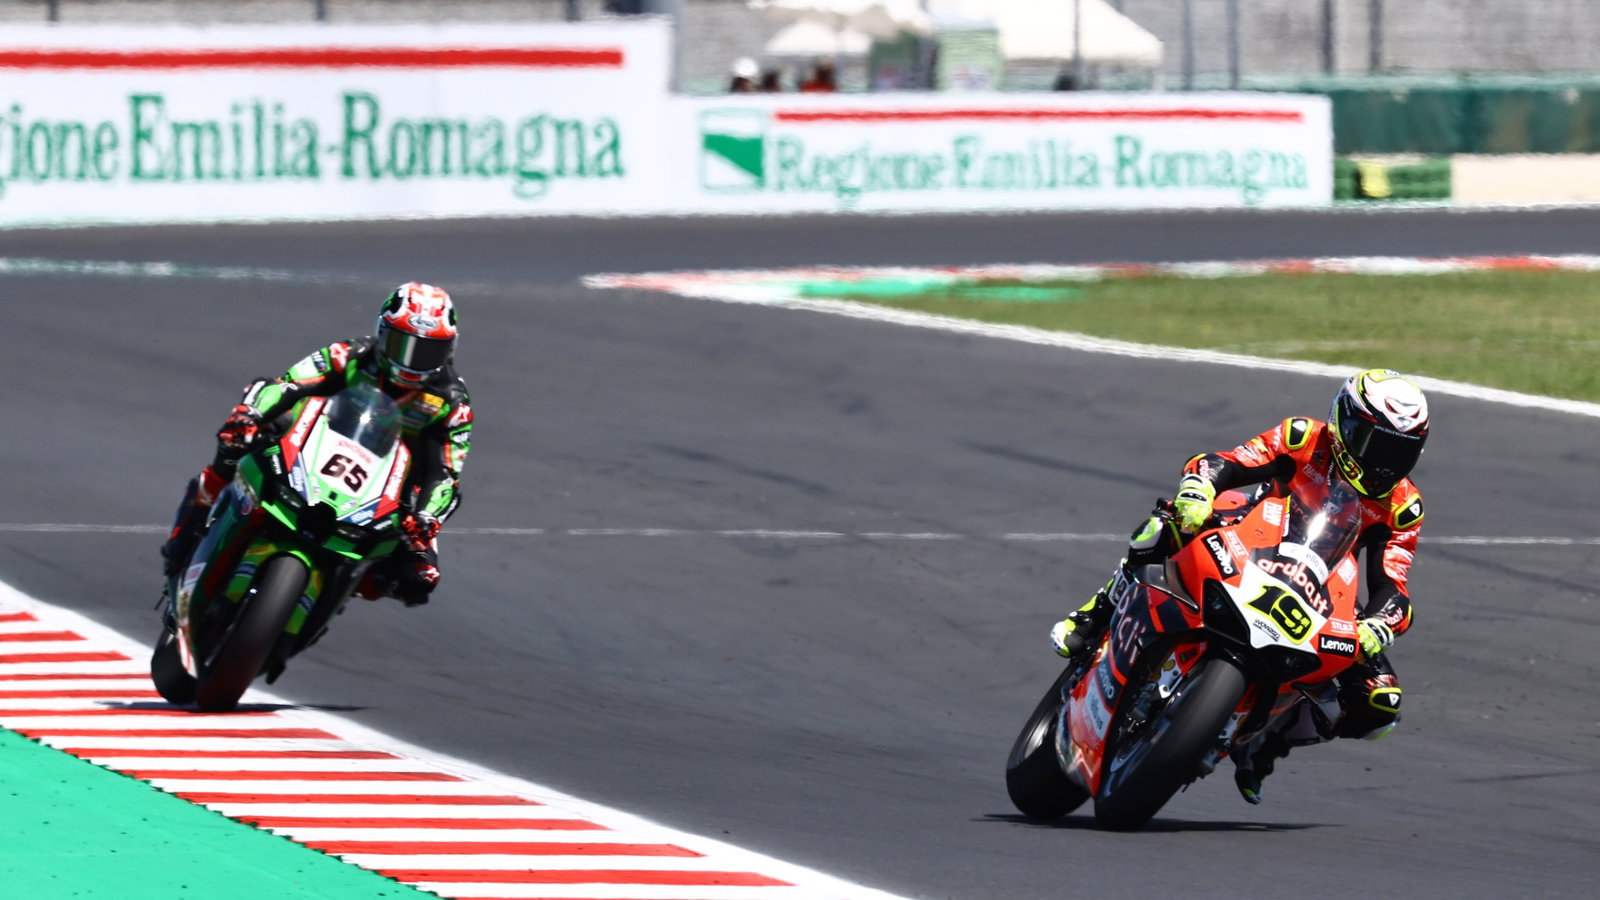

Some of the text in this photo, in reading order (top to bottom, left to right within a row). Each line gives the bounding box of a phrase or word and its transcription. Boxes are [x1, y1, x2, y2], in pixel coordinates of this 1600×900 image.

[0, 88, 627, 200] ione Emilia-Romagna
[775, 134, 1309, 209] Regione Emilia-Romagna
[320, 453, 368, 493] 65
[1206, 534, 1235, 575] Lenovo
[1244, 585, 1314, 644] 19
[1256, 557, 1329, 616] aruba.it
[1320, 636, 1356, 654] Lenovo
